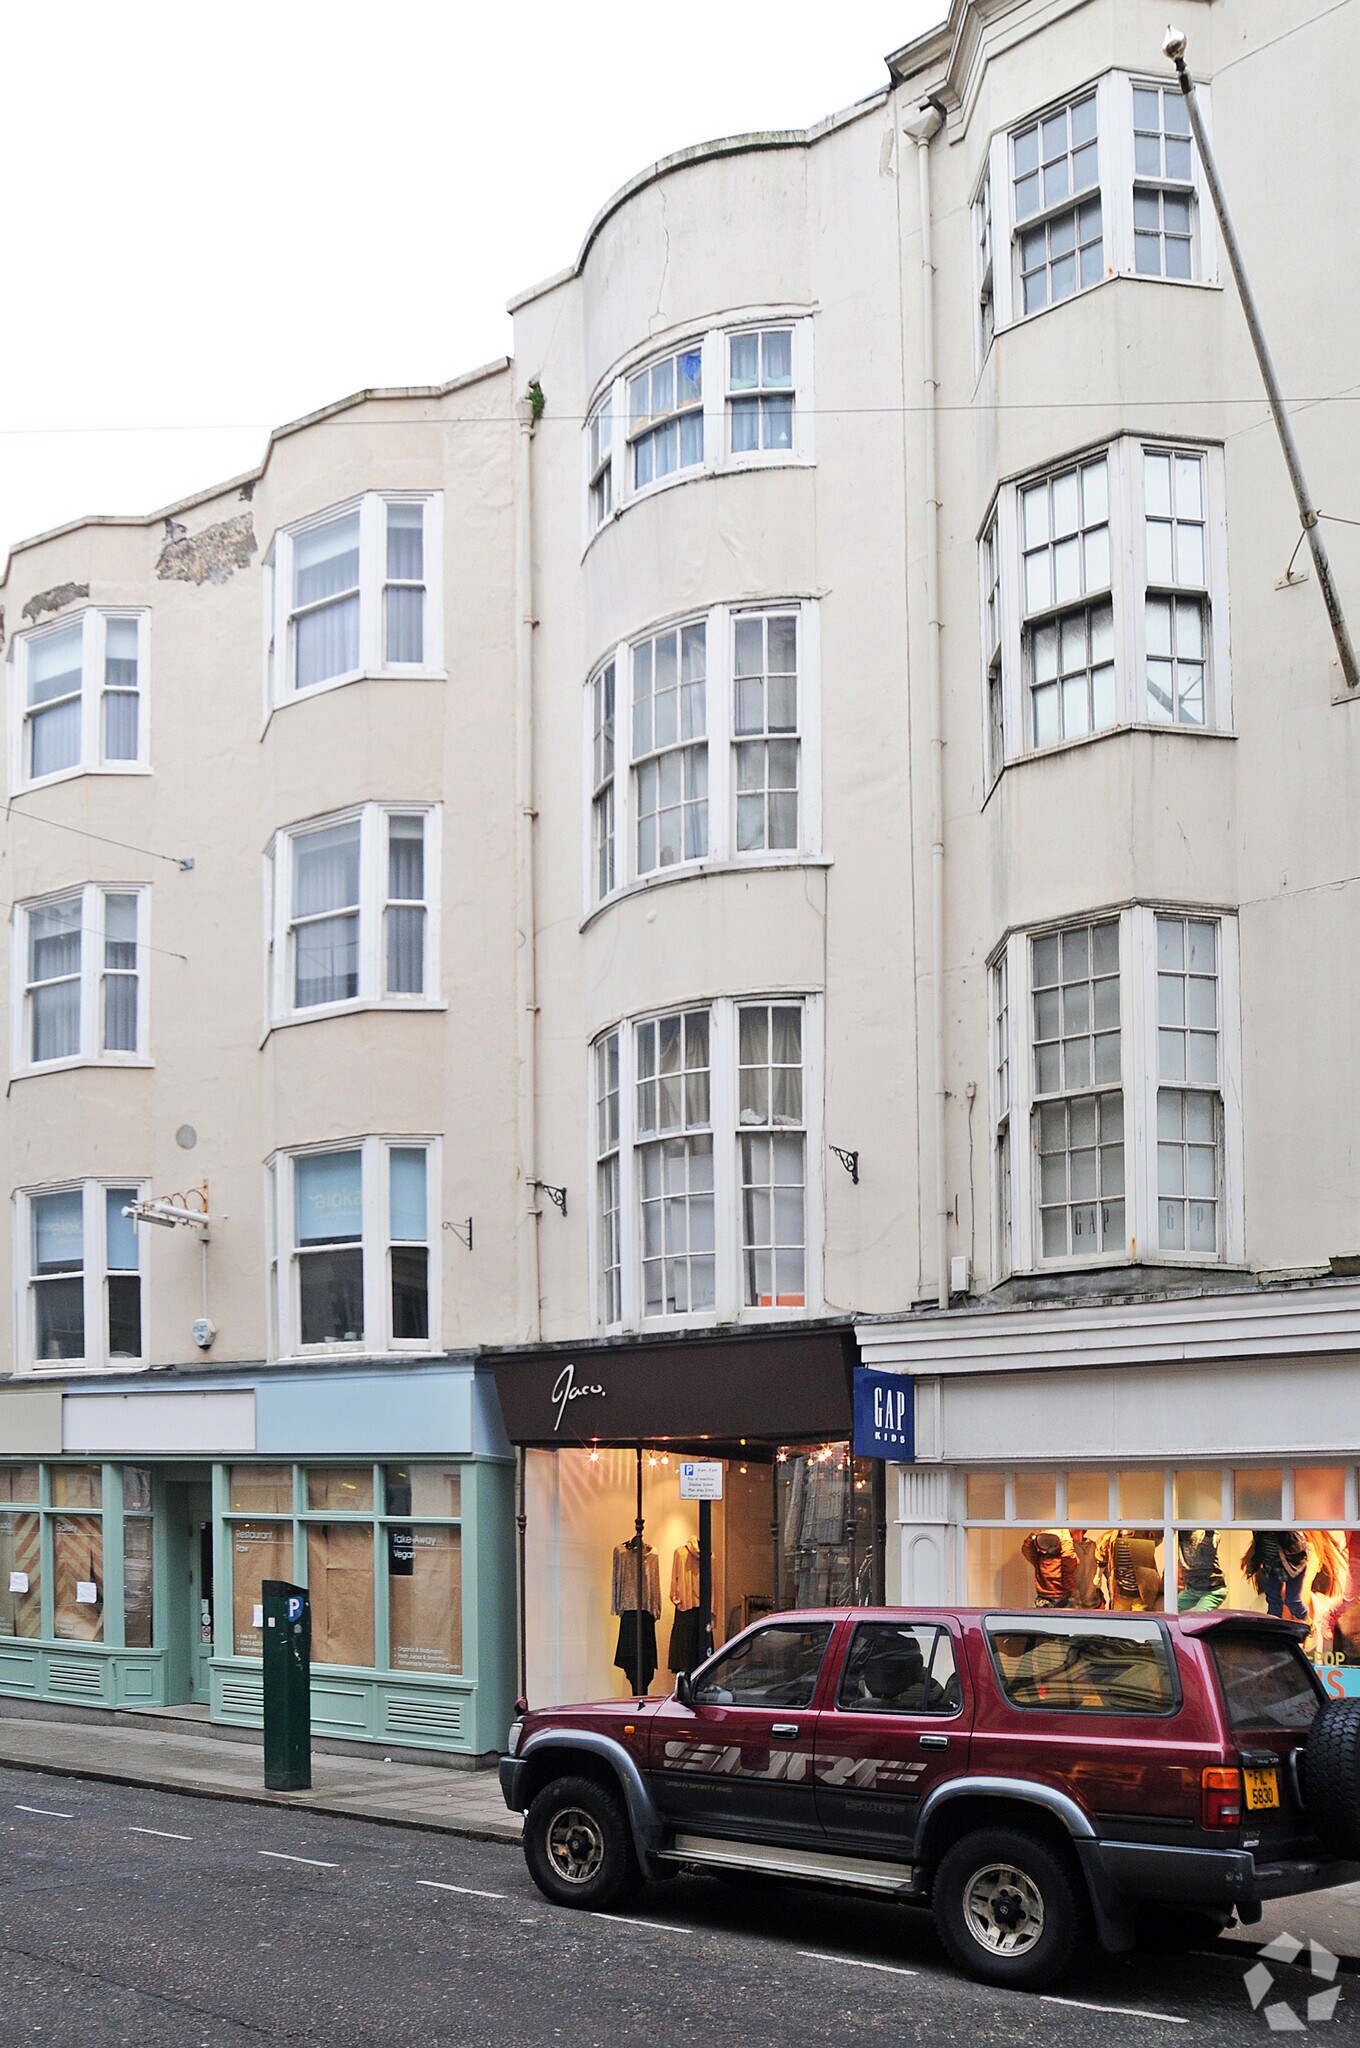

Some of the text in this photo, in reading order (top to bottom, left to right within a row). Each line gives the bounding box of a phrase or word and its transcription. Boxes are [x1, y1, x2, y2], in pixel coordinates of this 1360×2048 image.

[1075, 1208, 1109, 1235] GAP
[1167, 1205, 1204, 1231] GP
[874, 1386, 905, 1431] GAP
[874, 1431, 905, 1444] KIDS
[686, 1465, 693, 1475] P
[236, 1529, 272, 1540] Restaurant
[393, 1533, 437, 1546] Take-Away
[236, 1544, 249, 1552] Raw
[393, 1550, 416, 1560] Vegan
[288, 1598, 300, 1617] P
[663, 1740, 928, 1788] SURF
[1253, 1770, 1267, 1786] FIL
[1252, 1788, 1274, 1805] 5830
